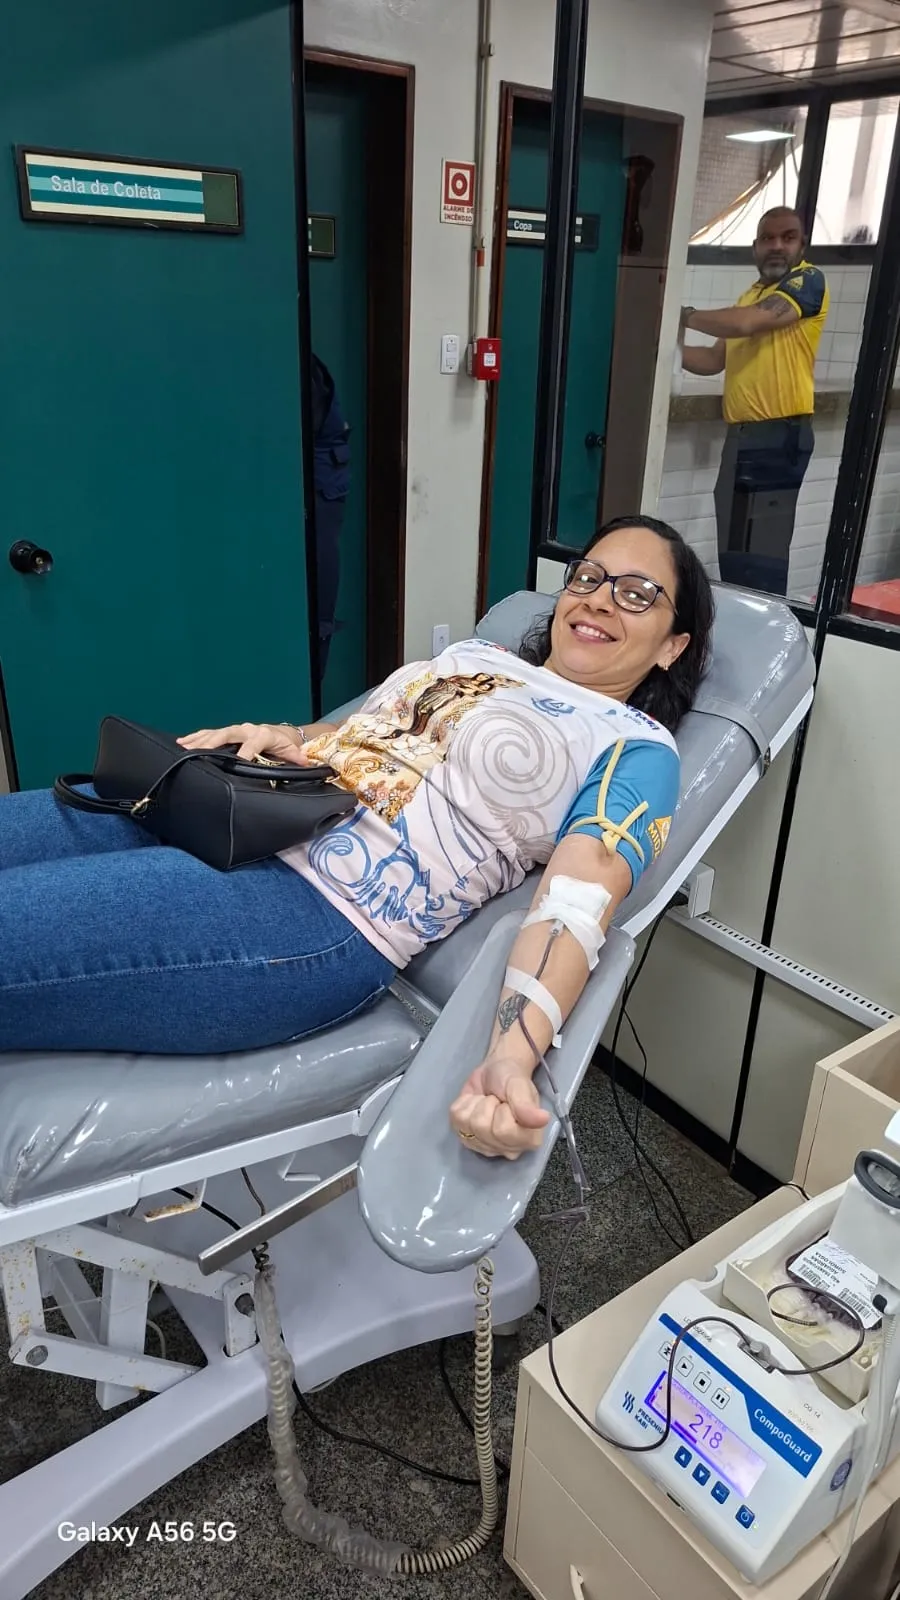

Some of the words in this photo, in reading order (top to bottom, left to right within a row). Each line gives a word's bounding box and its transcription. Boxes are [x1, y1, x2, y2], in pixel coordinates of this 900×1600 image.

[51, 175, 85, 193] Sala
[90, 179, 109, 195] de
[114, 181, 161, 200] Coleta
[443, 204, 465, 213] ALARME
[444, 212, 473, 222] INCÊNDIO
[513, 220, 533, 231] Copa
[634, 1414, 649, 1429] KABI
[637, 1408, 665, 1435] FRESENIU
[688, 1414, 723, 1449] 218
[754, 1408, 812, 1462] CompoGuard
